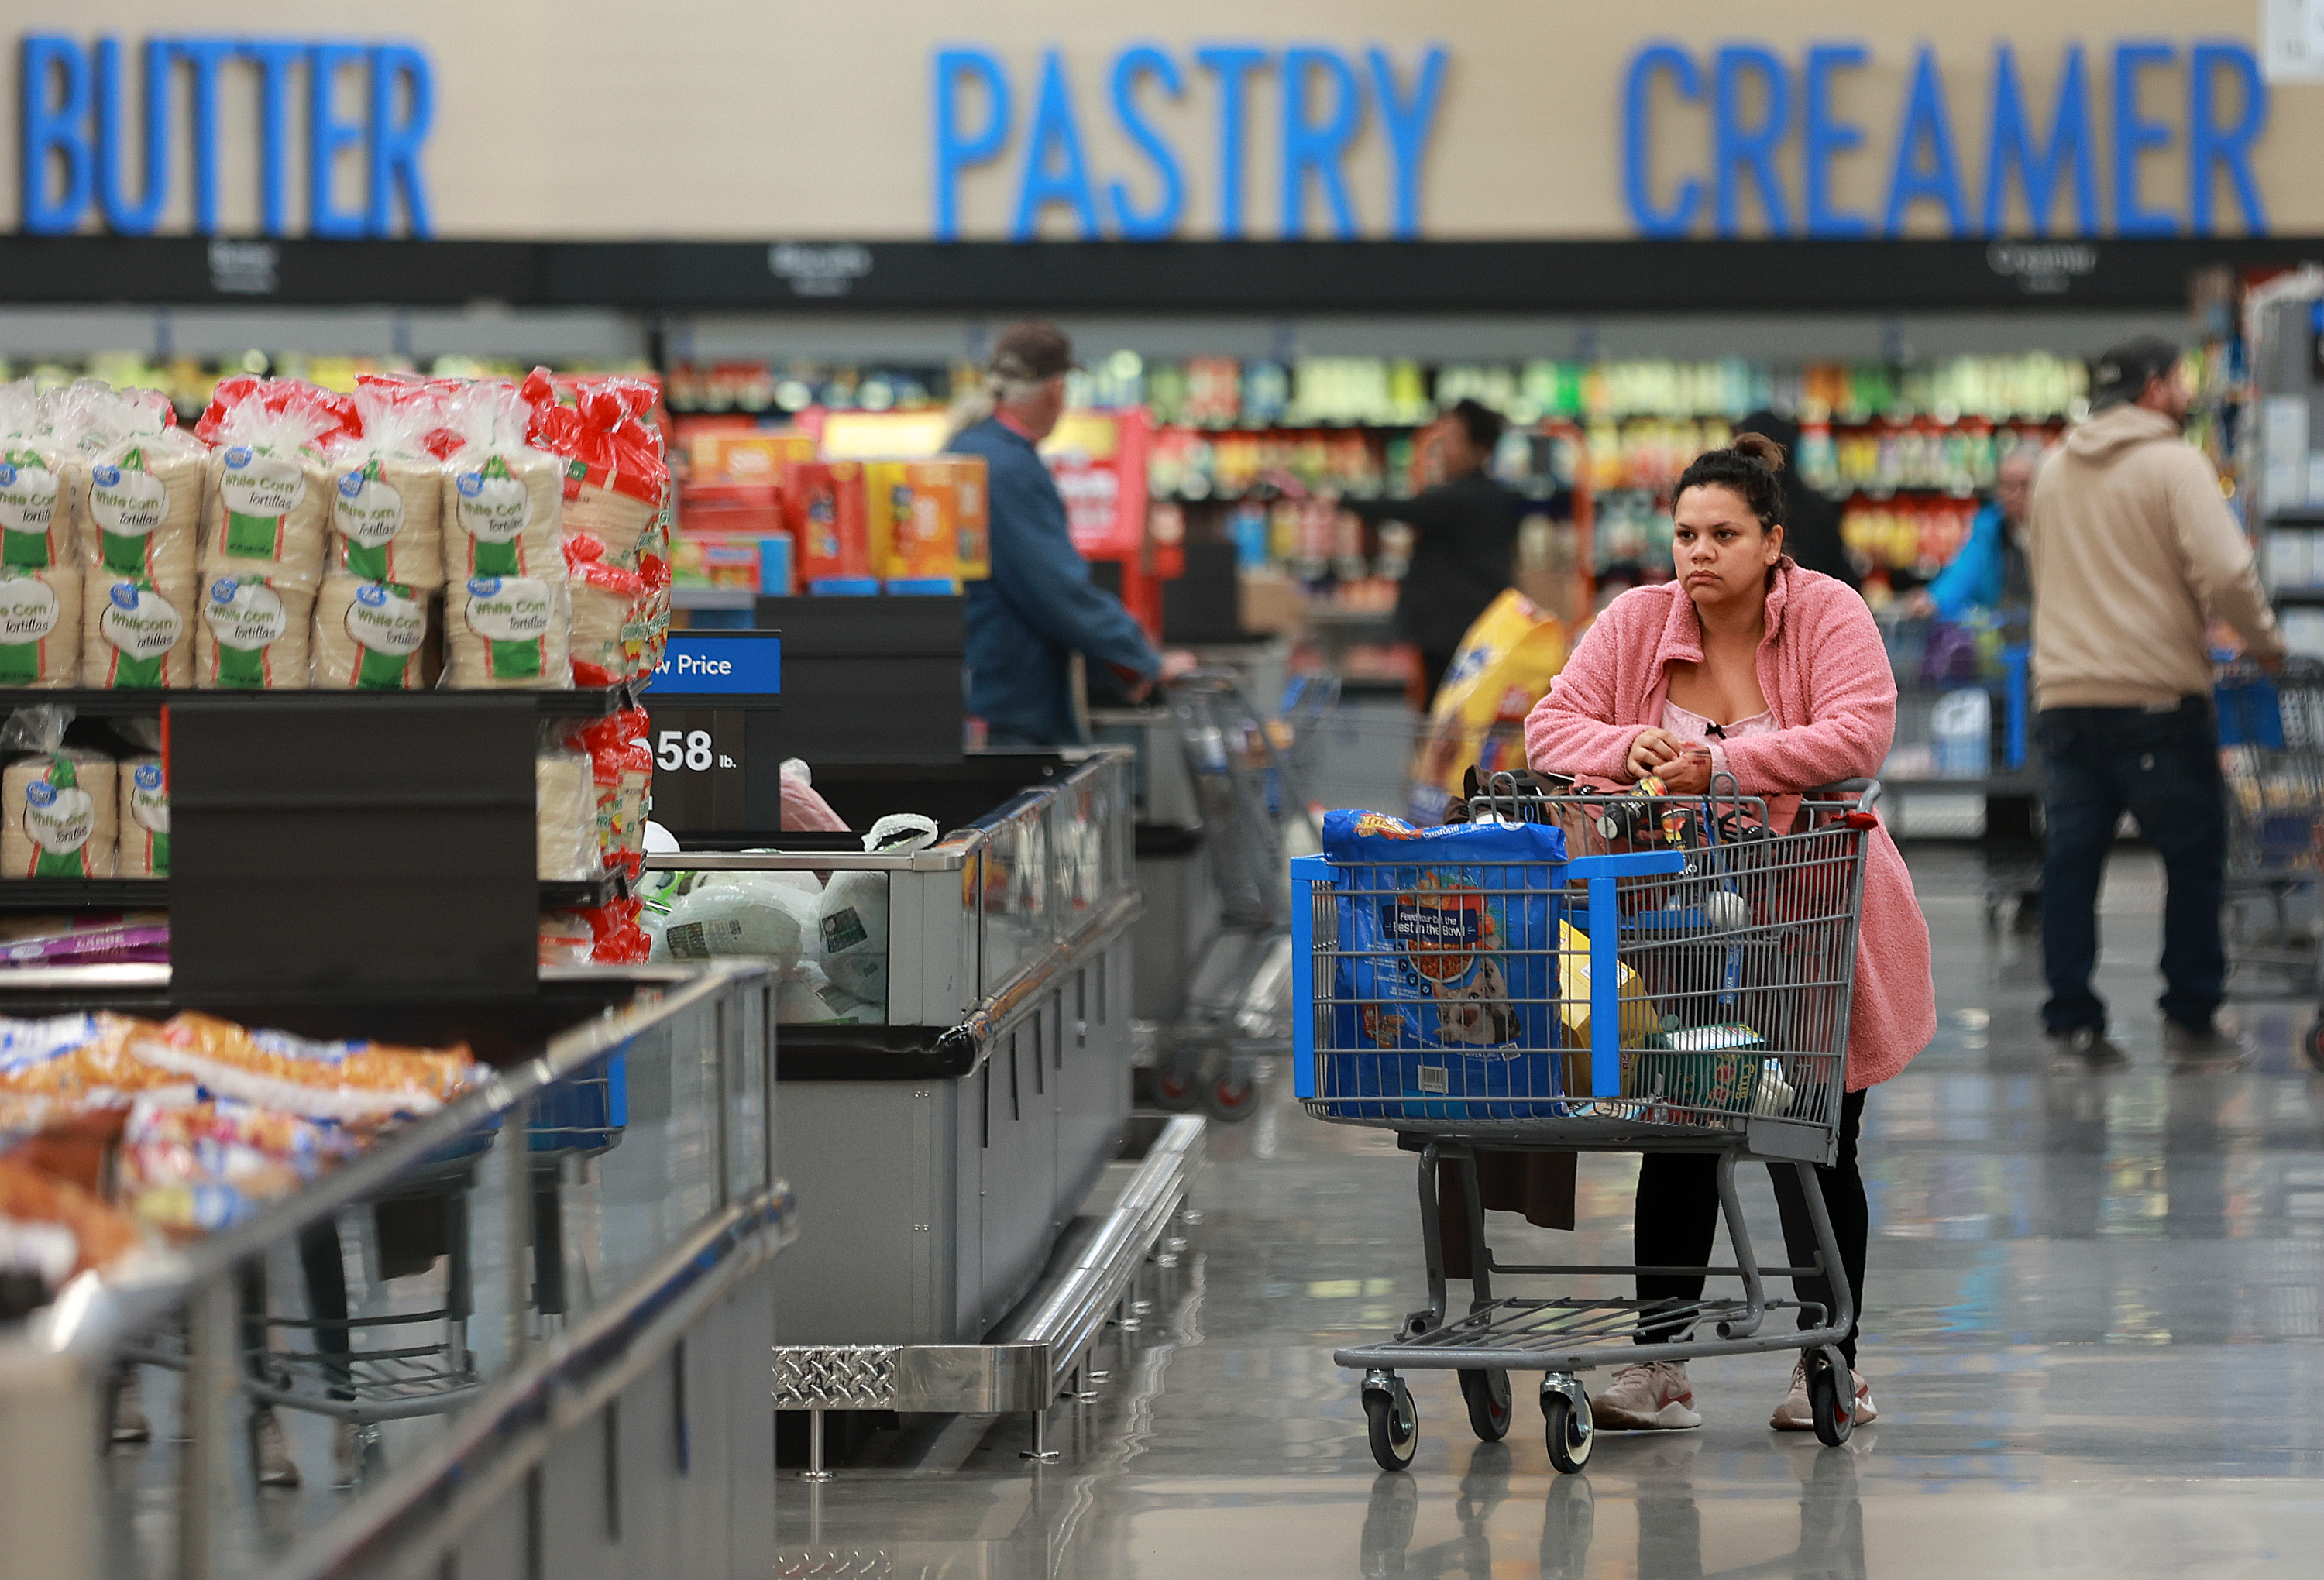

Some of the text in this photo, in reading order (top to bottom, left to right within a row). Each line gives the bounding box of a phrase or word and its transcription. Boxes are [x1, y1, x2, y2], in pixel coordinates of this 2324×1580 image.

[22, 36, 436, 239] BUTTER
[933, 46, 1448, 242] PASTRY
[1621, 40, 2270, 239] CREAMER
[225, 474, 294, 493] White Corn
[249, 491, 292, 510] Tortillas
[22, 507, 52, 522] Tortill
[370, 507, 395, 520] orn
[12, 604, 47, 617] Corn
[475, 599, 545, 616] White Corn
[244, 610, 273, 623] Corn
[357, 608, 421, 629] White Corn
[509, 615, 547, 630] Tortillas
[6, 618, 48, 634] Tortillas
[235, 624, 275, 639] Tortillas
[136, 633, 173, 649] ortillas
[678, 654, 732, 675] Price
[656, 730, 737, 771] 58 lb.
[1400, 912, 1418, 922] Feed
[1432, 915, 1444, 925] Ct
[1445, 915, 1457, 926] the
[1426, 923, 1441, 936] the
[1442, 925, 1466, 937] Bowl
